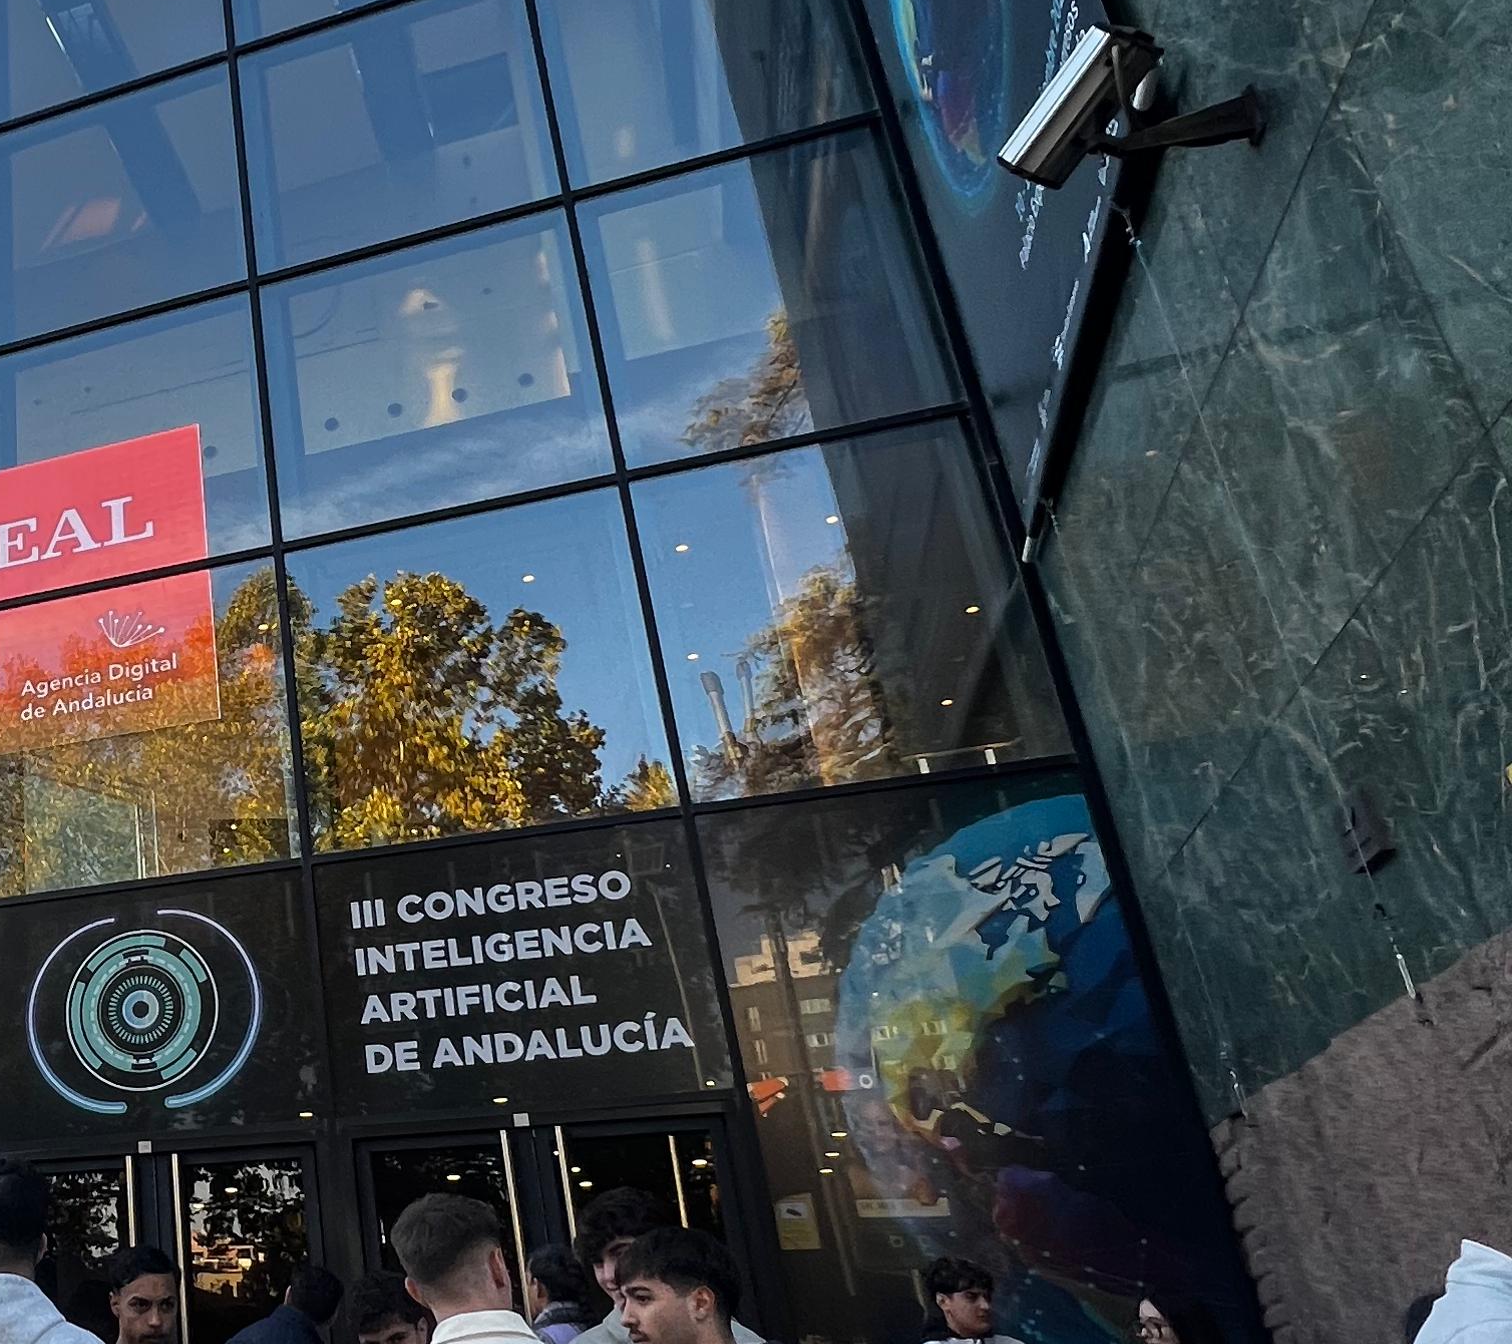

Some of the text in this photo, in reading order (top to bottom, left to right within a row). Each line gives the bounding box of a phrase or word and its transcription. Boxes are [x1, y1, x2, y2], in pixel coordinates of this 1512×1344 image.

[21, 653, 177, 698] Agencia Digital
[21, 703, 46, 721] de
[350, 870, 632, 929] III CONGRESO
[355, 917, 653, 977] INTELIGENCIA
[360, 975, 598, 1025] ARTIFICIAL
[365, 1011, 696, 1074] DE ANDALUCÍA
